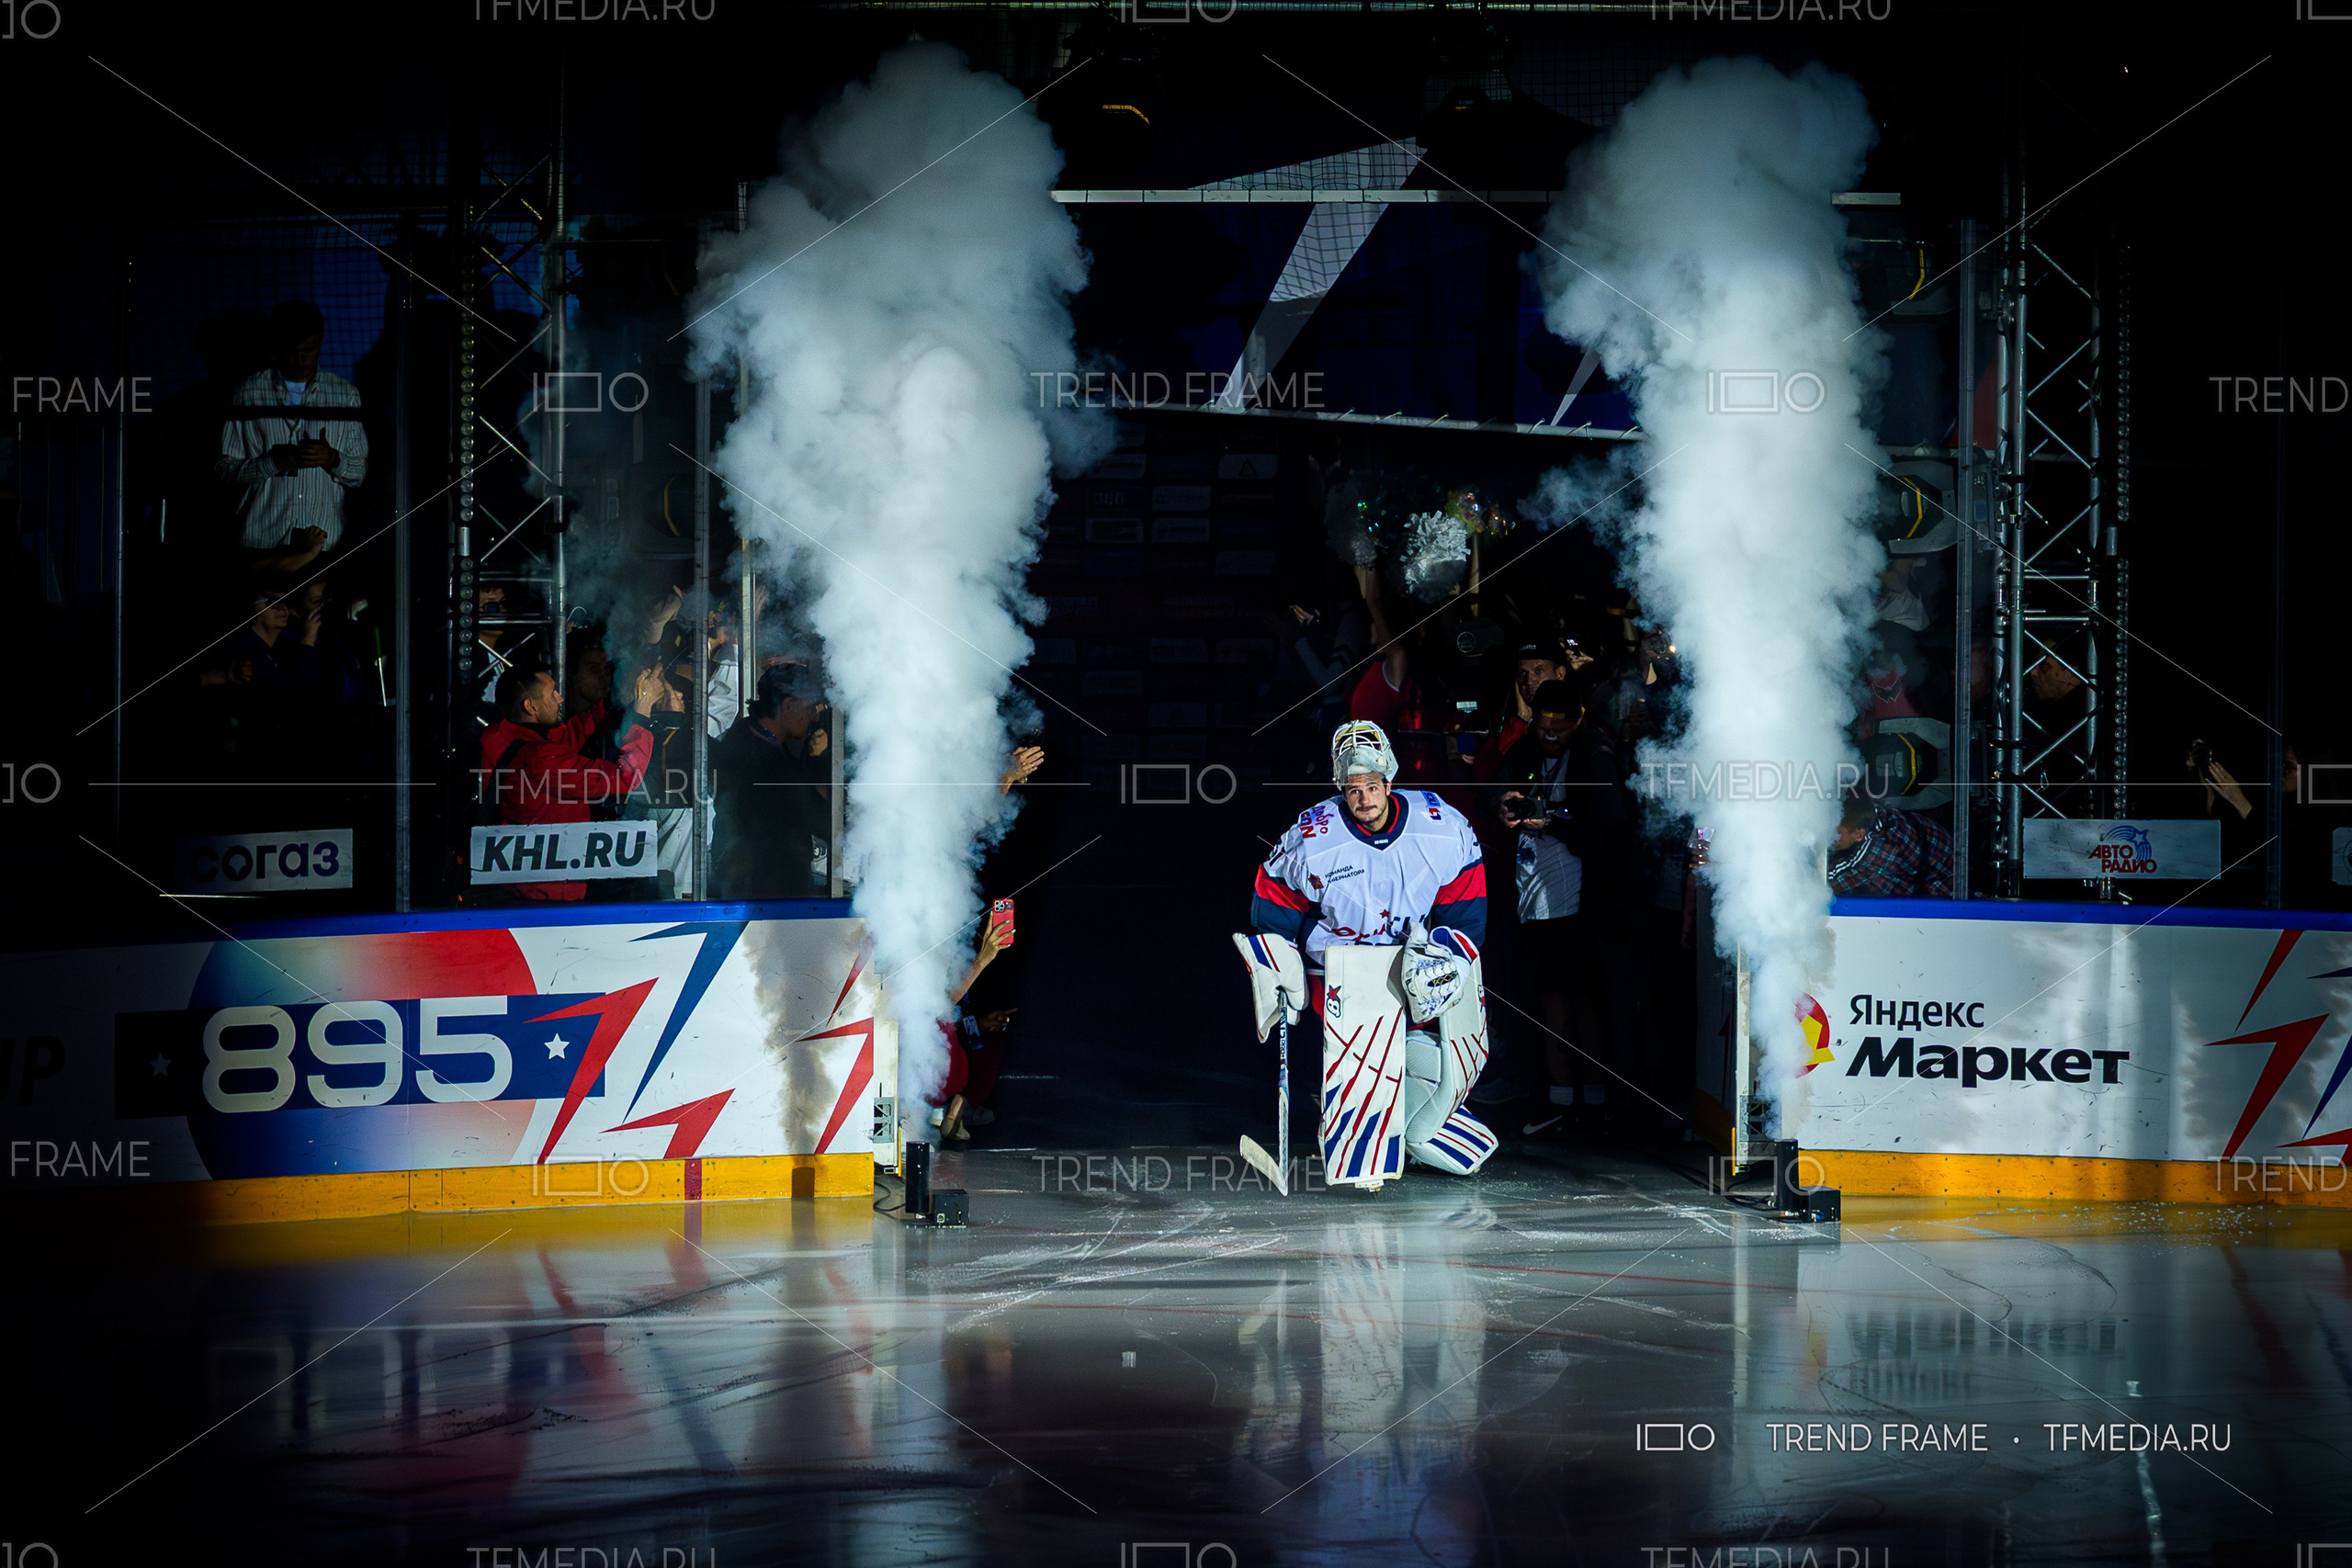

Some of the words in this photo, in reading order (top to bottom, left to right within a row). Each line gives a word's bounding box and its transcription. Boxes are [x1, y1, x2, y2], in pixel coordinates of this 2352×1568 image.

[481, 830, 647, 872] KHL.RU
[2087, 844, 2134, 860] АВТО
[2101, 858, 2158, 874] РАДИО
[1849, 994, 1984, 1032] Яндекс
[202, 995, 513, 1113] 895
[1845, 1036, 2131, 1089] Маркет
